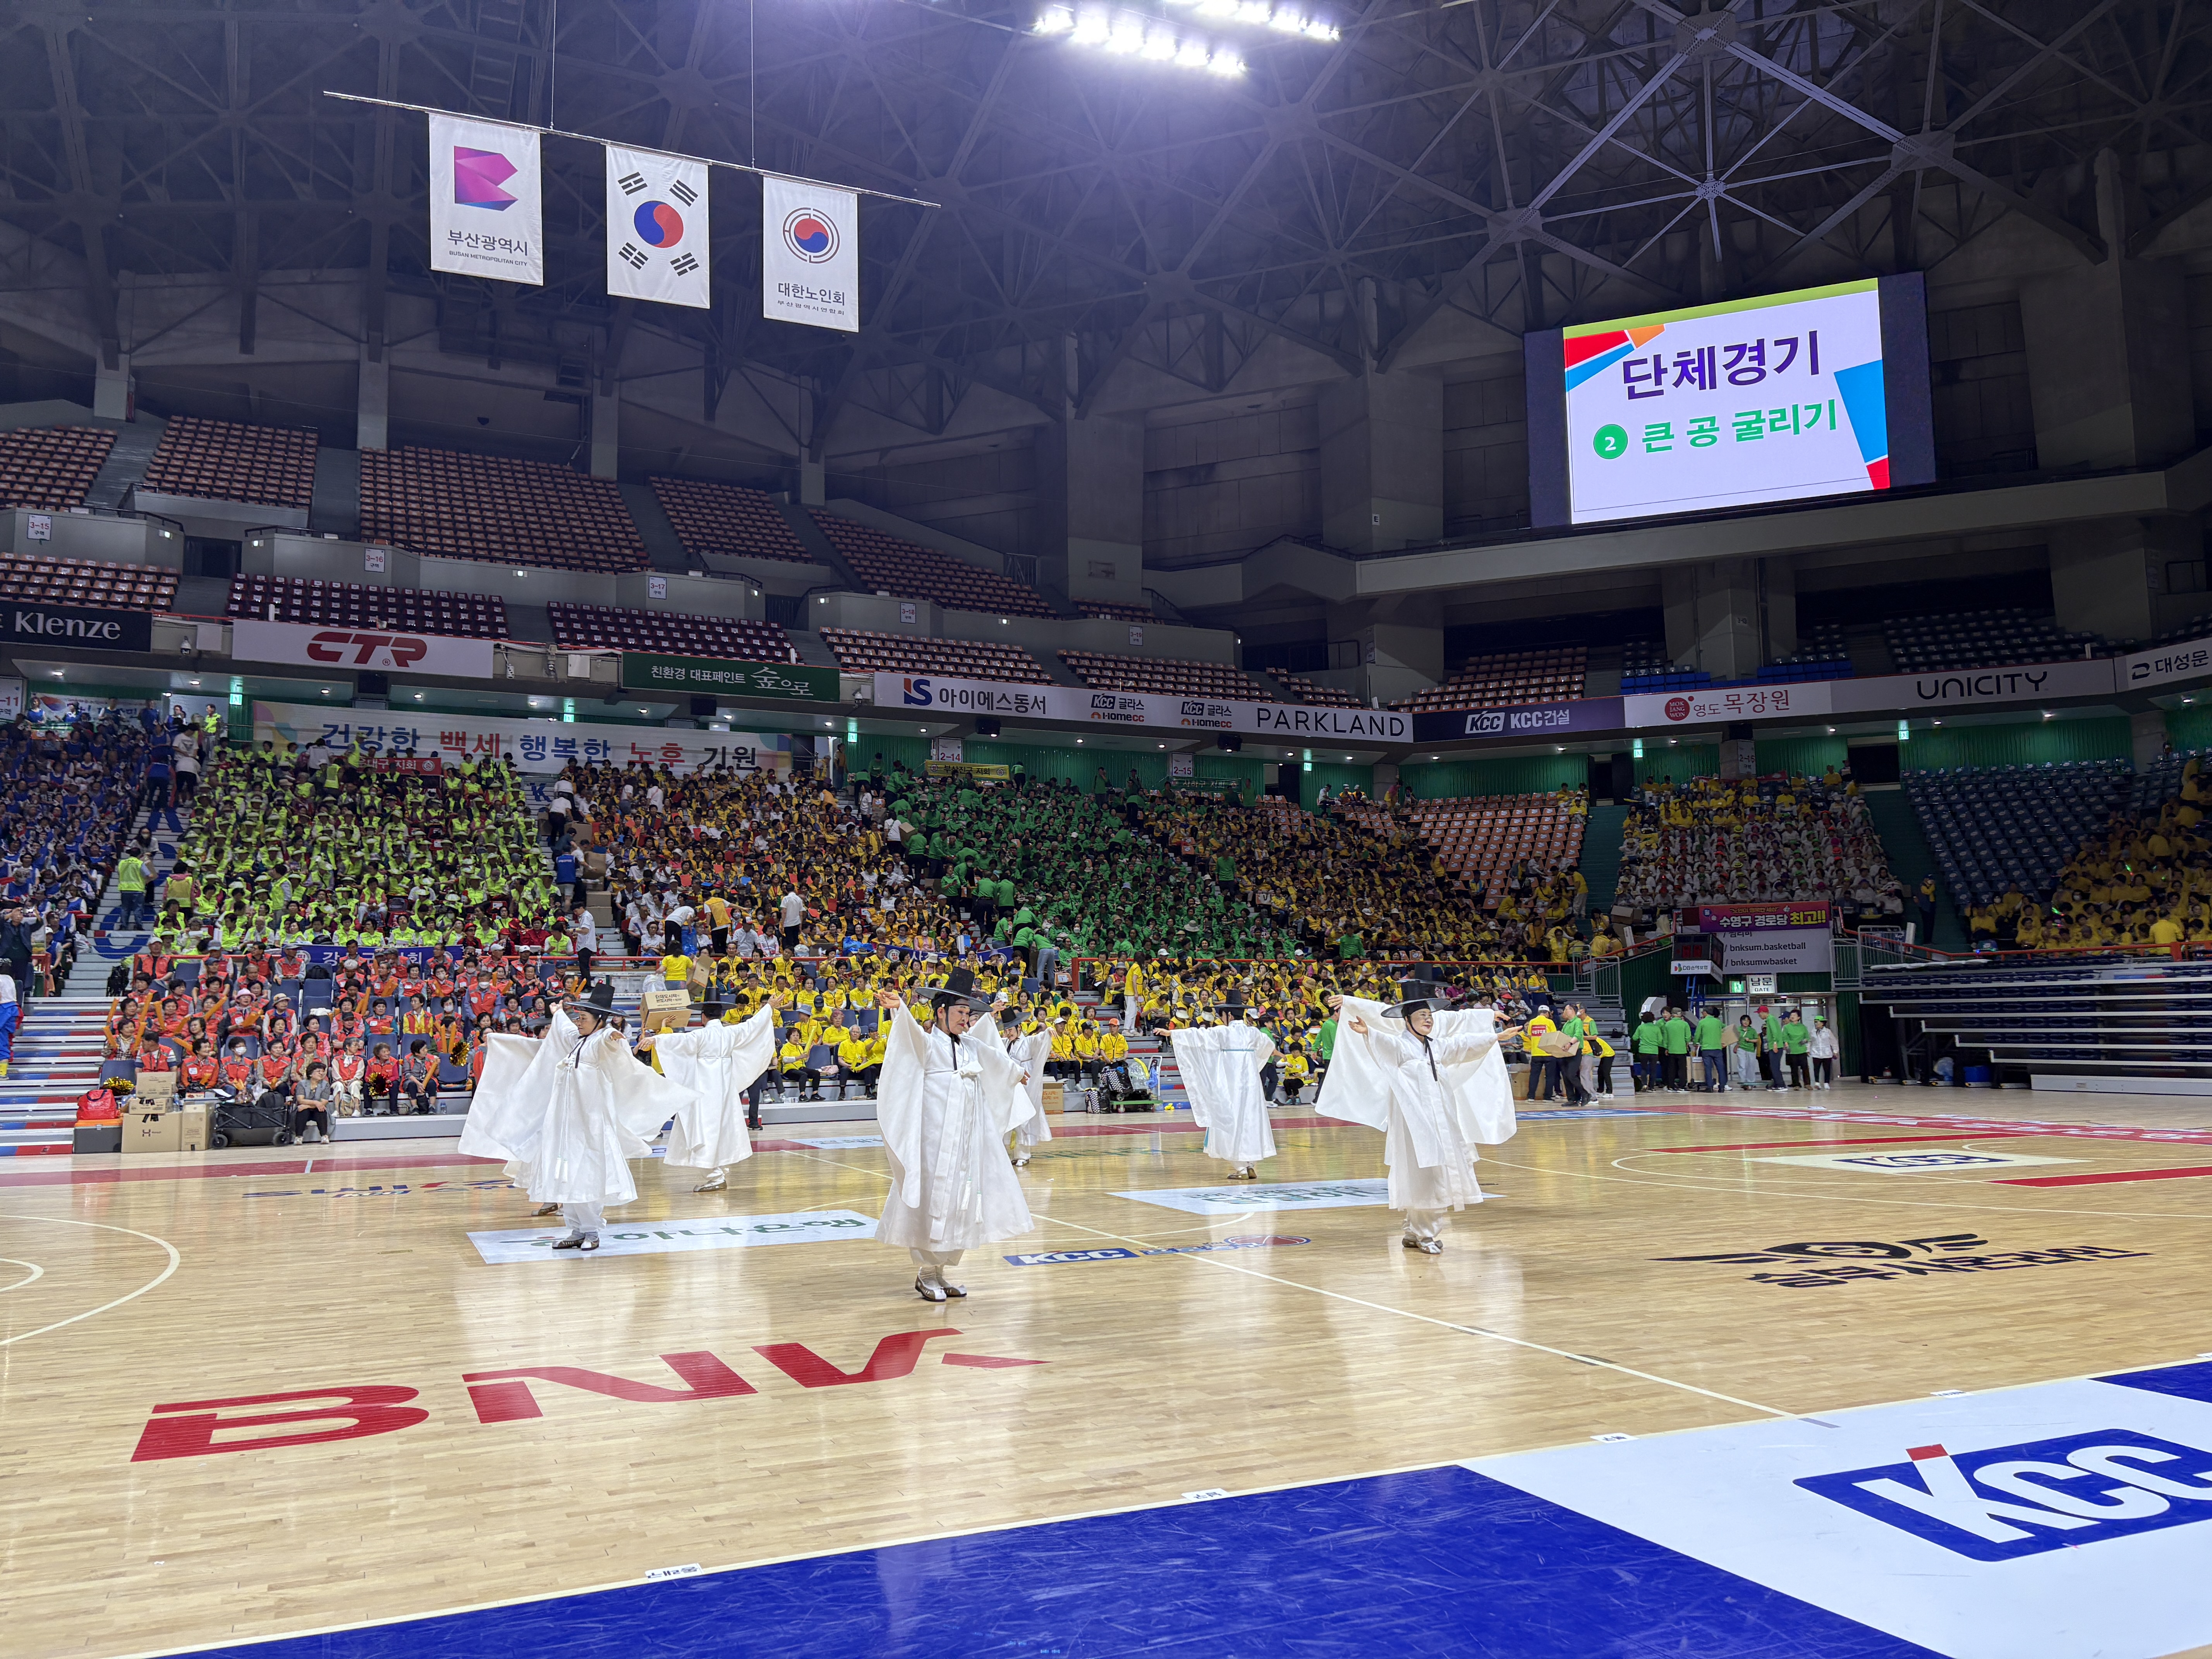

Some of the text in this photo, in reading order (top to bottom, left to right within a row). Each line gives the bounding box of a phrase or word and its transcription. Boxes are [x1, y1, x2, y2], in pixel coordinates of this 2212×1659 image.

[448, 229, 529, 256] 부산광역시
[470, 253, 514, 265] METROPOLITAN
[777, 282, 845, 306] 대한노인회
[1623, 330, 1820, 400] 단체경기
[1605, 399, 1837, 453] 2 큰 공 굴리기
[15, 611, 120, 640] Klenze
[307, 631, 427, 668] CTR
[2155, 650, 2209, 673] 대성문
[651, 666, 813, 696] 친환경 대표페인트 숲으로
[1917, 671, 2047, 700] UNICITY
[939, 688, 1046, 715] 아이에스동서
[1092, 693, 1144, 710] KCC 글라스
[1182, 700, 1232, 717] KCC 글라스
[1693, 689, 1790, 717] 영도 목장원
[1257, 708, 1405, 737] PARKLAND
[1468, 710, 1503, 731] KCC
[321, 723, 756, 771] 건강한 백세 행복한 노후 기원
[940, 752, 960, 761] 2-14
[394, 759, 416, 769] 지회
[1174, 766, 1192, 775] 2-15
[1719, 910, 1826, 928] 수영구 경로당 최고!!
[1730, 942, 1806, 951] bnksum.basketball
[1731, 958, 1797, 966] bnksumwbasket
[1751, 977, 1772, 986] 남문
[1854, 1154, 1990, 1168] KCC
[611, 1219, 868, 1240] 하나은행
[1017, 1248, 1126, 1265] KCC
[1746, 1244, 2153, 1288] 승부사온라인
[130, 1328, 1053, 1463] BNK
[1852, 1443, 2212, 1544] KCC
